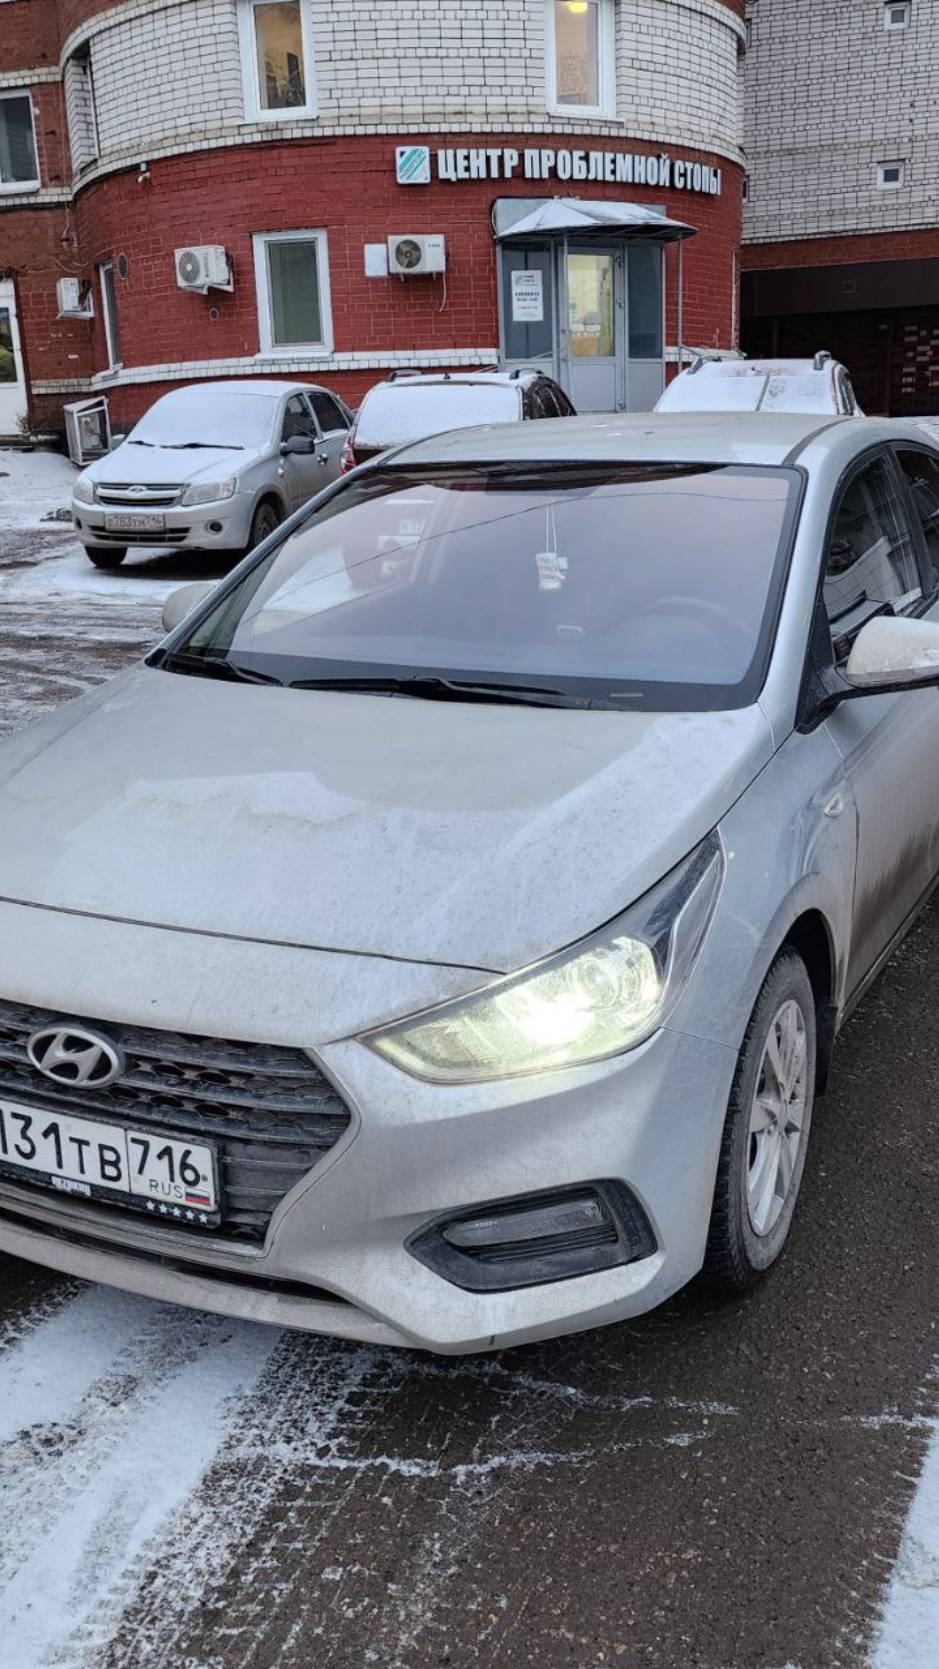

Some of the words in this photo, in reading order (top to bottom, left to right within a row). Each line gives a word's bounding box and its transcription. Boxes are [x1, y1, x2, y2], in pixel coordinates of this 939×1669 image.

[437, 148, 519, 182] ЦЕНТР
[524, 148, 671, 186] ПРОБЛЕМНОЙ
[673, 160, 721, 195] СТОПЫ
[130, 1137, 201, 1187] 716
[149, 1178, 184, 1200] RUS
